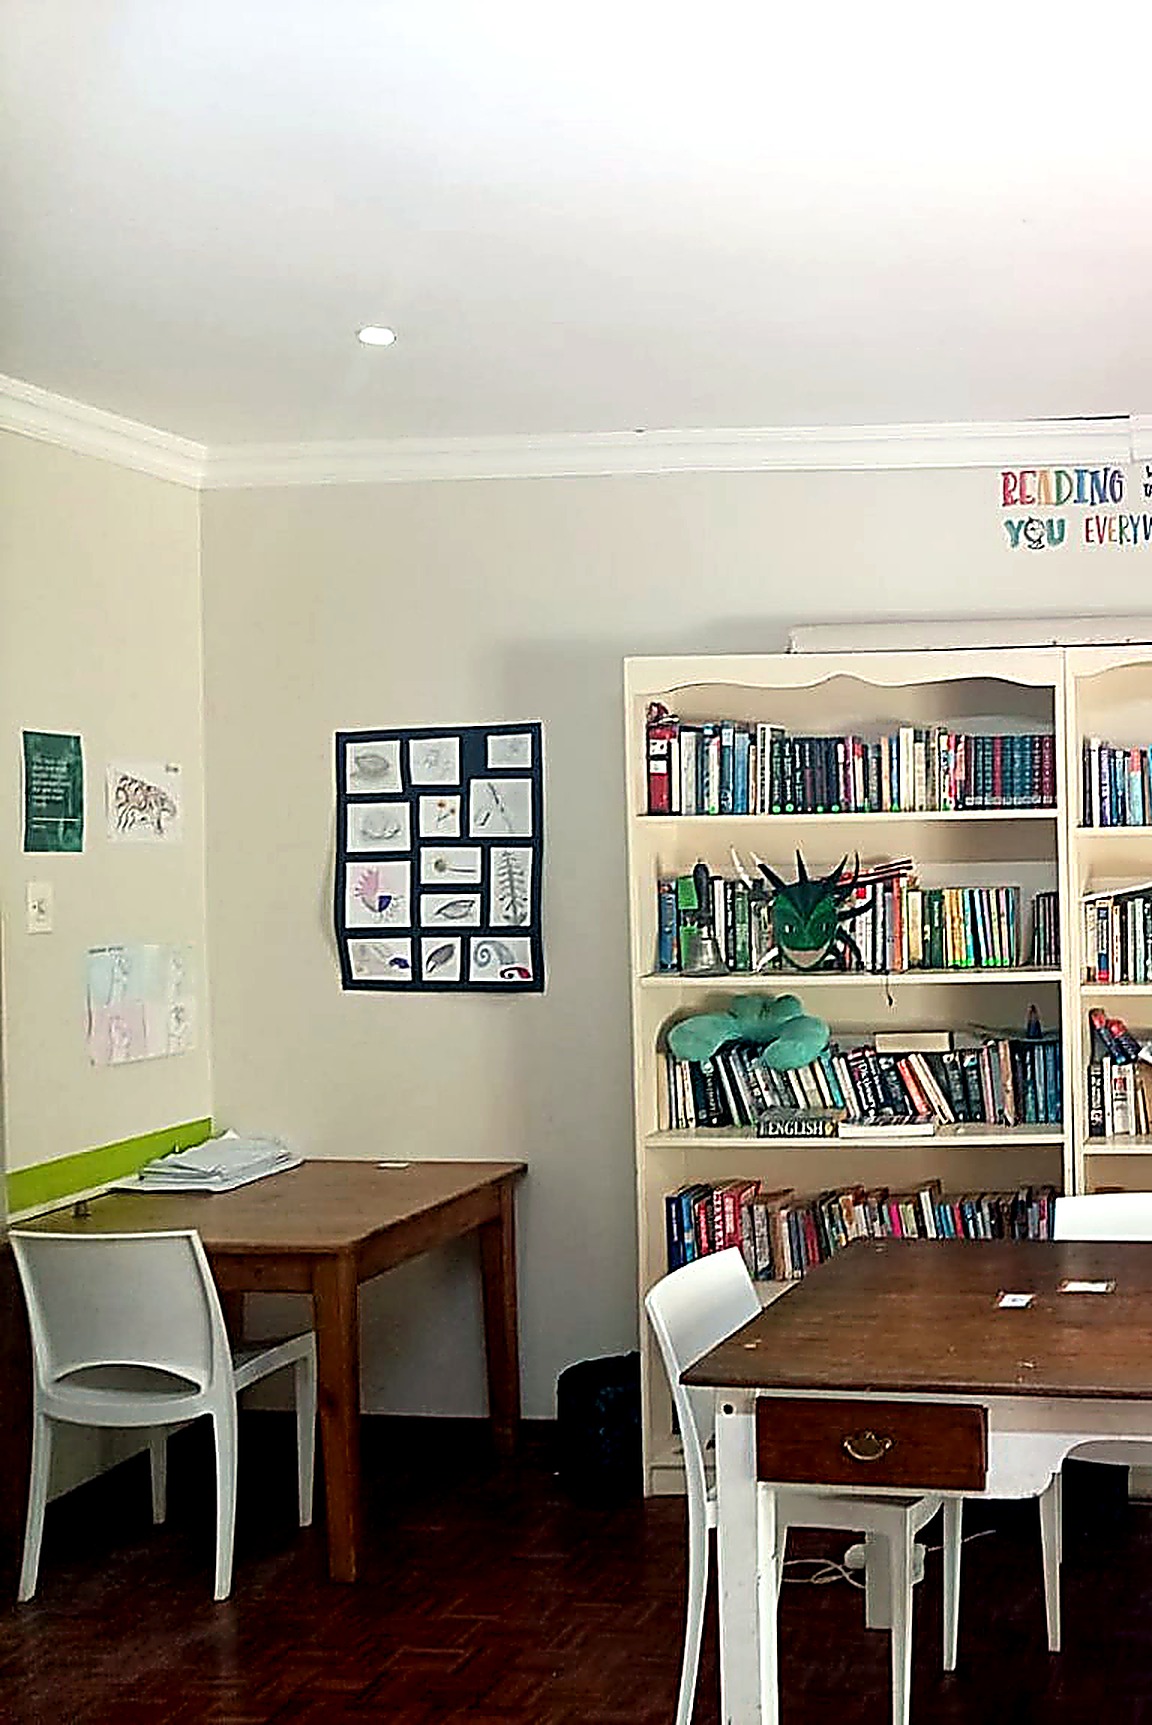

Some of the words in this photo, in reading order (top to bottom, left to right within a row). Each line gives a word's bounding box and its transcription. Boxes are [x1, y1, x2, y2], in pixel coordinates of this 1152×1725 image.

[1001, 467, 1125, 507] READING
[1004, 516, 1066, 550] YOU
[768, 1121, 823, 1136] ENGLISH
